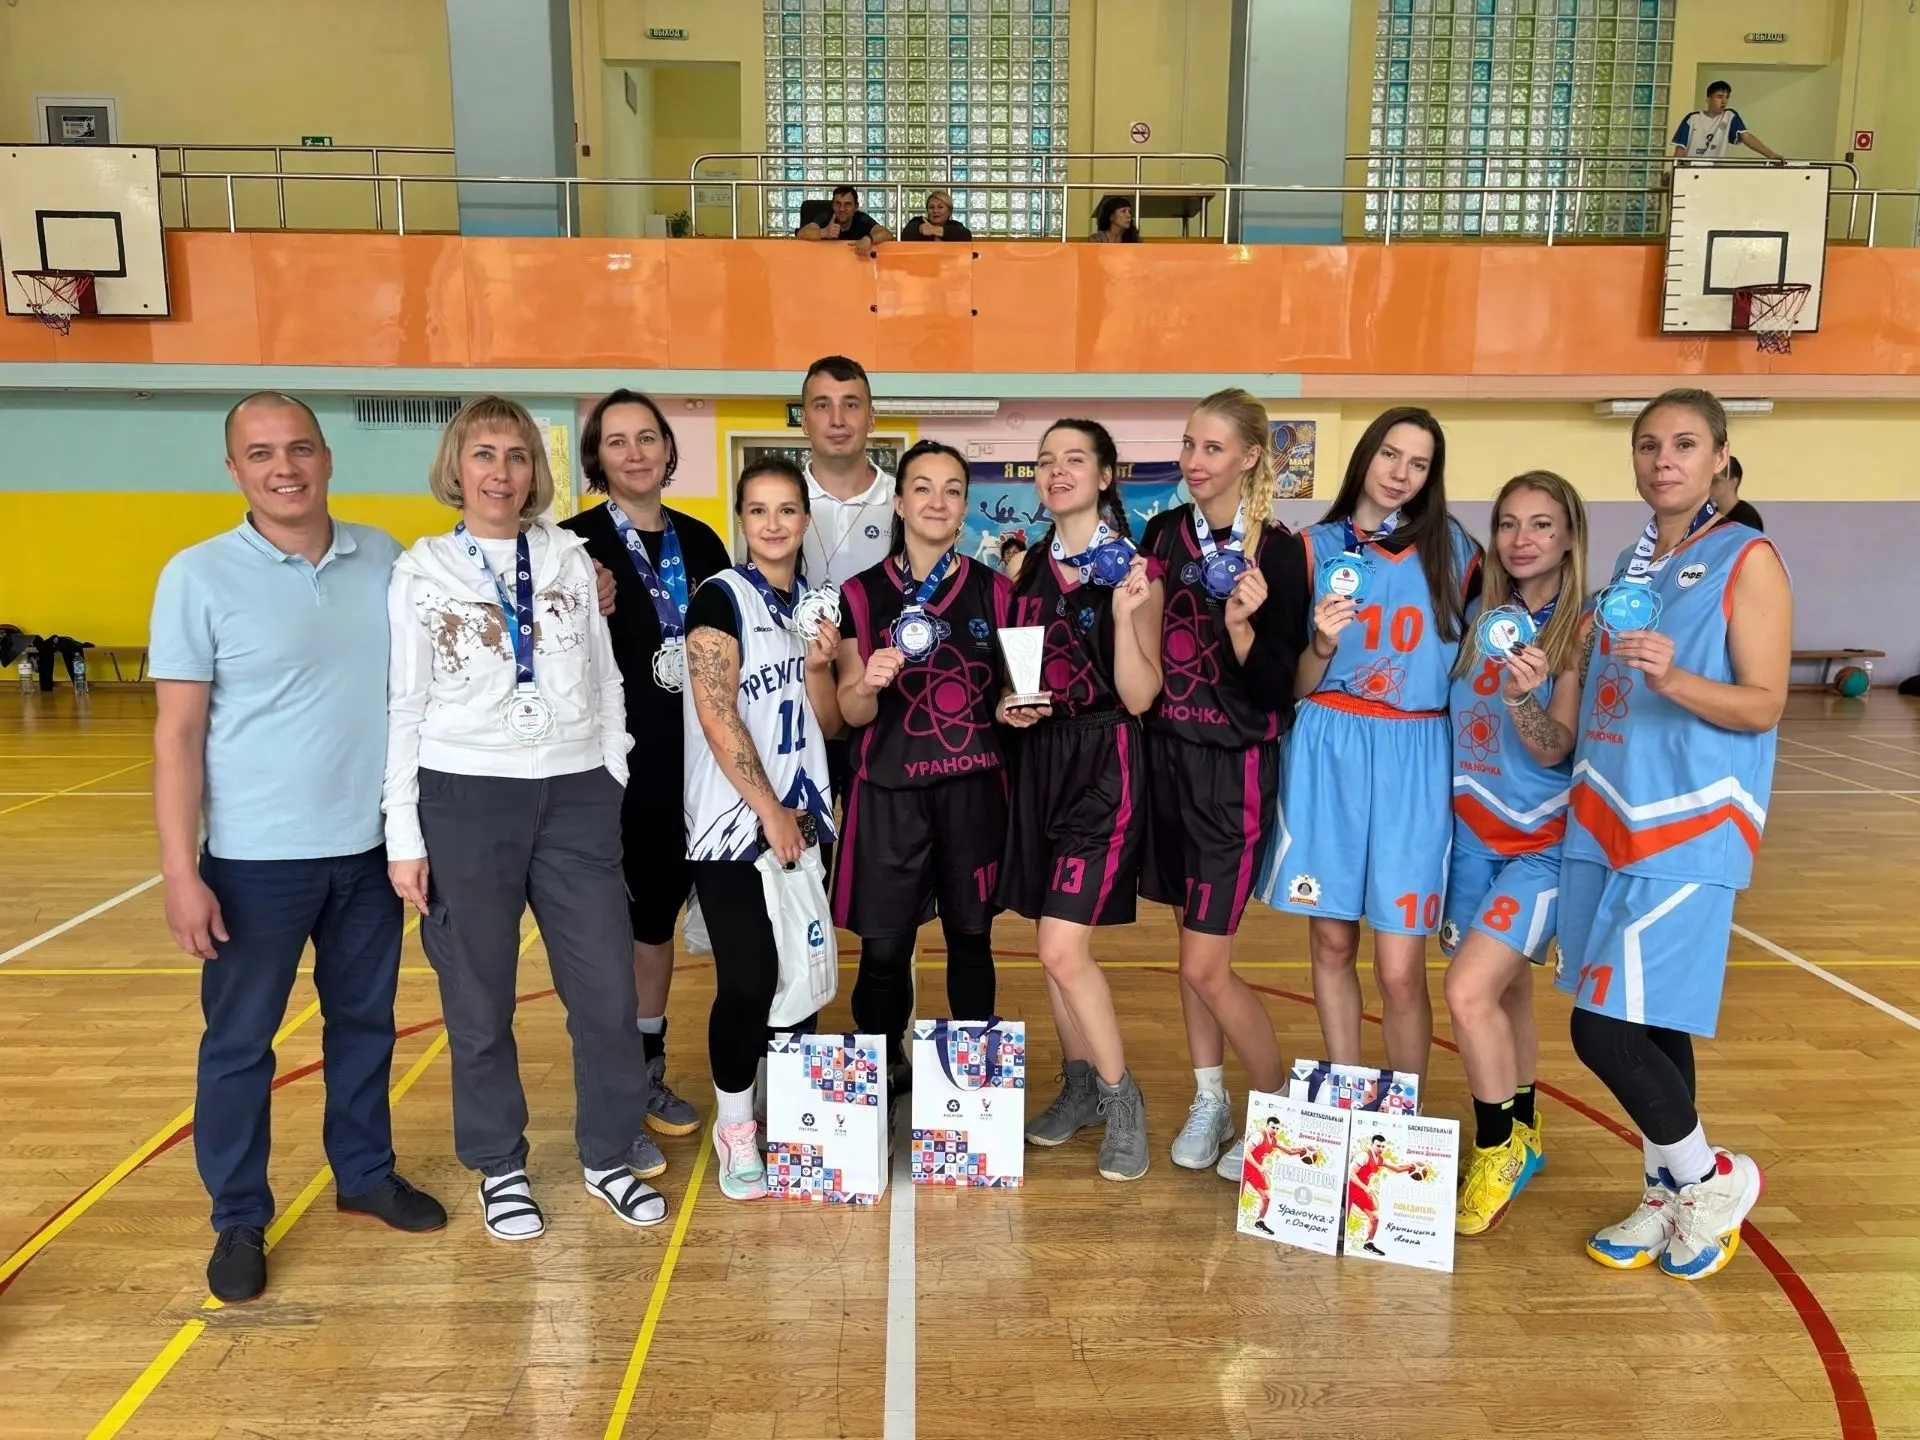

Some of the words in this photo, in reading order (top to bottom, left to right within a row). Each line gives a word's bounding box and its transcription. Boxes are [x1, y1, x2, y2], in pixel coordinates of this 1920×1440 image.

[654, 29, 682, 38] ВЫХОД
[1755, 33, 1783, 41] ВЫХОД
[1289, 458, 1310, 466] МАЯ
[1004, 463, 1014, 478] Я
[1017, 465, 1037, 478] вы
[1681, 571, 1703, 579] РФБ
[1355, 604, 1424, 653] 10
[1472, 656, 1506, 696] 8
[1160, 703, 1231, 726] НОЧКА
[1585, 730, 1624, 744] РАНОЧКА
[904, 752, 1000, 778] УРАНОЧКА
[1459, 760, 1502, 776] УРАНОЧКА
[1051, 856, 1086, 894] 13
[1394, 893, 1441, 929] 10
[1482, 895, 1520, 932] 8
[1300, 1109, 1344, 1123] БАСКЕТБОЛЬНЫЙ
[1407, 1124, 1453, 1135] БАСКЕТБОЛЬНЫЙ
[1273, 1163, 1338, 1190] ДИПЛОМ
[1393, 1202, 1436, 1214] ПОБЕДИТЕЛЬ
